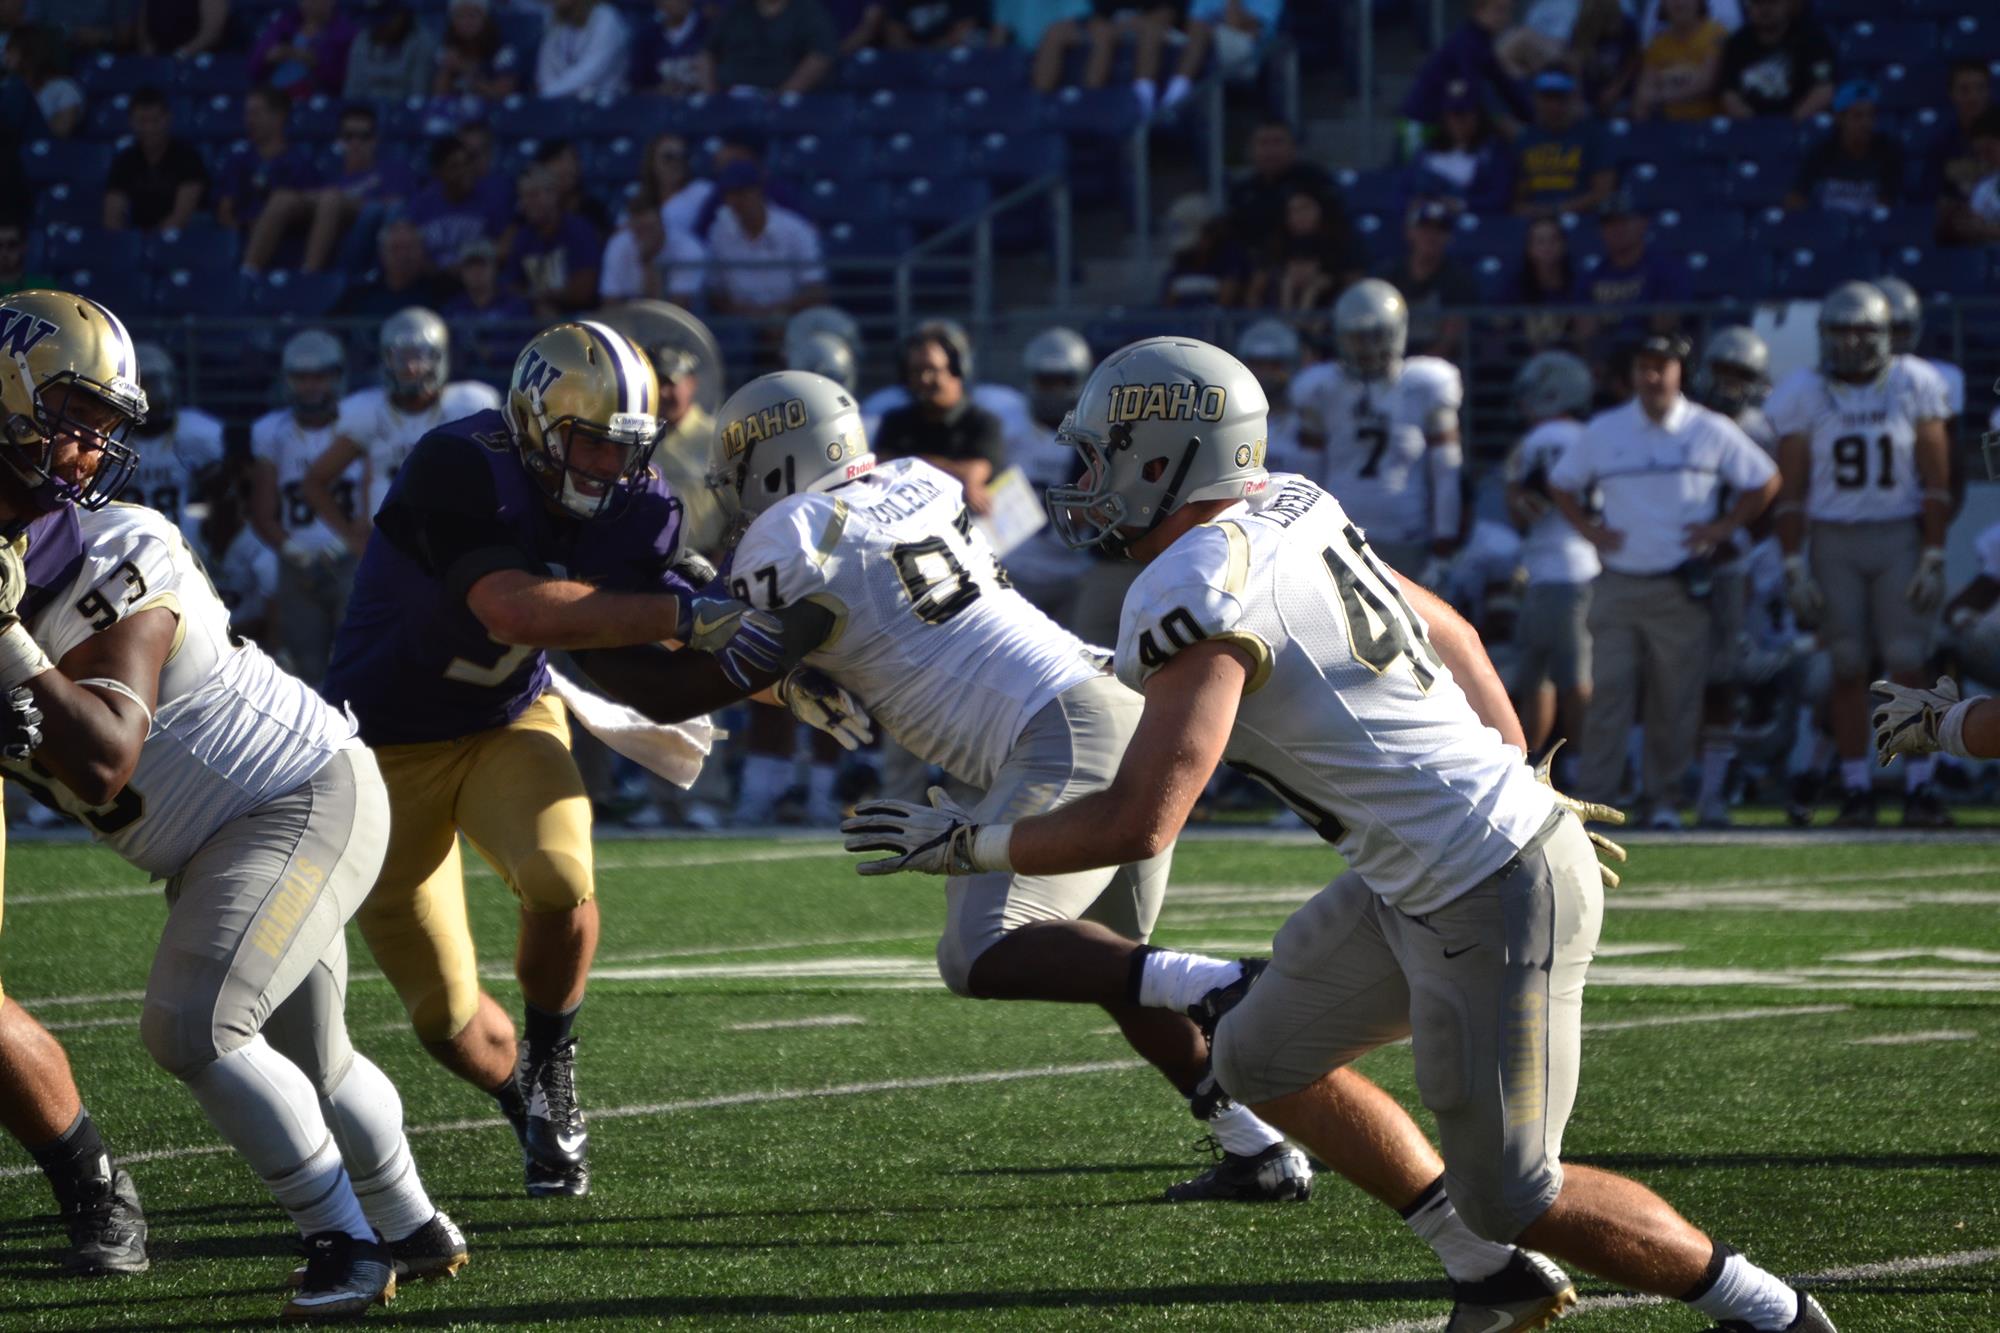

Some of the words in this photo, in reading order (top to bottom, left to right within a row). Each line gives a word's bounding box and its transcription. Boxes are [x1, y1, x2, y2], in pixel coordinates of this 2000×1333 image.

[0, 306, 60, 359] W
[518, 349, 563, 402] W
[1107, 382, 1227, 424] IDAHO
[720, 397, 807, 460] IDAHO
[1833, 433, 1895, 491] 91
[76, 561, 147, 631] 93
[732, 564, 786, 609] 97
[1138, 607, 1208, 667] 40
[251, 856, 325, 958] VANDALS
